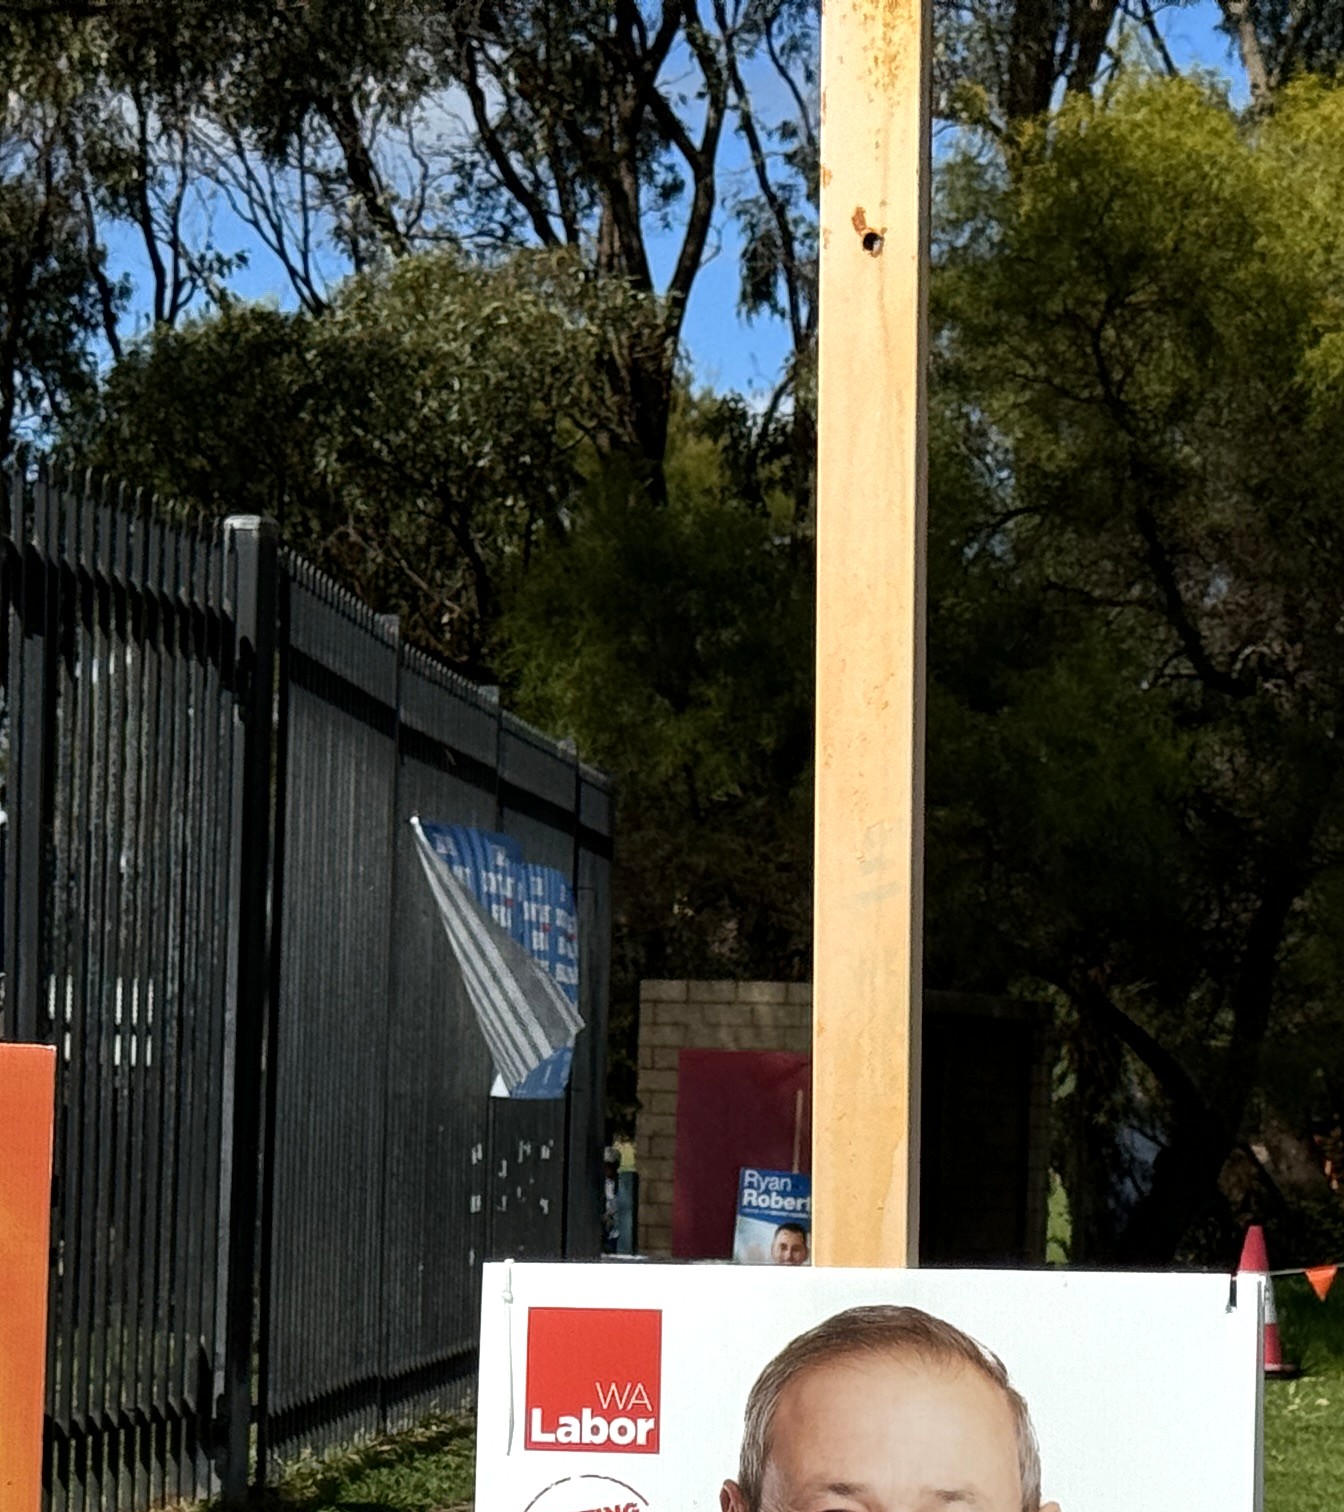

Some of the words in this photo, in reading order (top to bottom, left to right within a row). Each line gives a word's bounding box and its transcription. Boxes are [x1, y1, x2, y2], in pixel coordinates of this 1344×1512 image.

[743, 1169, 792, 1193] Ryan
[595, 1382, 652, 1412] WA
[531, 1407, 655, 1446] Labor
